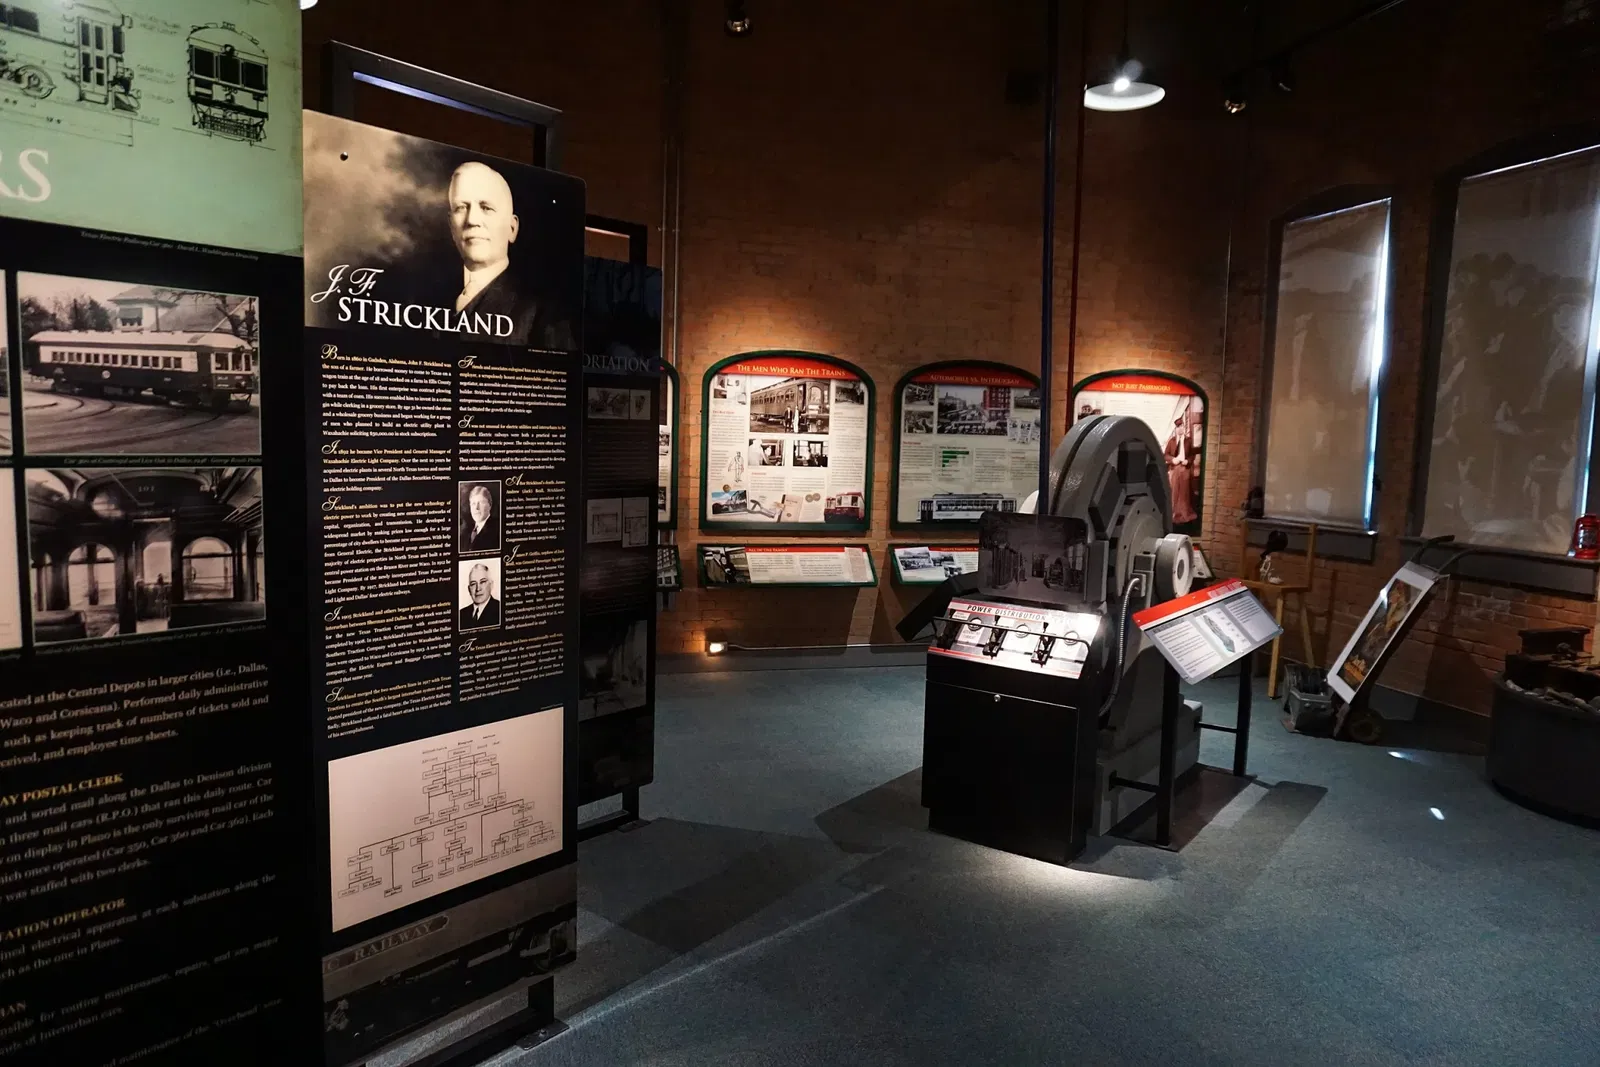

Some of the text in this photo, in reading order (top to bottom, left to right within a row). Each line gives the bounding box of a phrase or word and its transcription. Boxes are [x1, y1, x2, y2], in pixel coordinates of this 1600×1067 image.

[337, 296, 514, 337] STRICKLAND
[821, 368, 846, 376] TRAINS
[966, 604, 1046, 620] POWER DISTRIBUTION
[47, 690, 67, 702] the
[68, 683, 107, 699] Central
[109, 680, 147, 693] Depots
[147, 677, 157, 688] in
[160, 674, 189, 687] larger
[190, 669, 214, 681] cities
[239, 662, 268, 675] Dallas,
[0, 716, 33, 730] Waco
[35, 709, 58, 724] and
[123, 692, 176, 710] Performed
[178, 688, 201, 701] daily
[204, 679, 269, 697] administrative
[4, 733, 31, 748] such
[50, 725, 94, 740] keeping
[96, 718, 124, 733] track
[126, 715, 138, 727] of
[140, 710, 184, 725] numbers
[185, 705, 197, 717] of
[198, 701, 229, 714] tickets
[230, 697, 250, 709] sold
[252, 694, 270, 705] and
[43, 746, 65, 761] and
[66, 739, 119, 756] employee
[119, 734, 144, 746] time
[5, 760, 273, 826] and sorted mail along the Dallas to Denison division
[22, 782, 78, 803] POSTAL
[78, 772, 124, 791] CLERK
[6, 852, 21, 864] on
[24, 842, 65, 859] display
[66, 838, 79, 849] in
[80, 832, 112, 846] Plano
[112, 828, 122, 839] is
[123, 824, 141, 836] the
[142, 818, 164, 832] only
[166, 808, 211, 826] surviving
[211, 800, 233, 815] mail
[259, 792, 274, 803] the
[9, 830, 40, 845] three
[42, 820, 68, 836] mail
[70, 817, 93, 830] cars
[140, 801, 162, 815] that
[164, 798, 181, 809] ran
[183, 792, 202, 805] this
[203, 786, 226, 800] daily
[257, 777, 273, 788] Car
[23, 864, 52, 879] once
[53, 850, 101, 872] operated
[150, 834, 170, 847] Car
[190, 823, 209, 837] and
[30, 876, 68, 896] staffed
[70, 871, 95, 886] with
[32, 928, 82, 951] electrical
[85, 914, 138, 936] apparatus
[183, 887, 232, 906] substation
[53, 897, 127, 926] OPERATOR
[354, 922, 433, 961] RAILWAY
